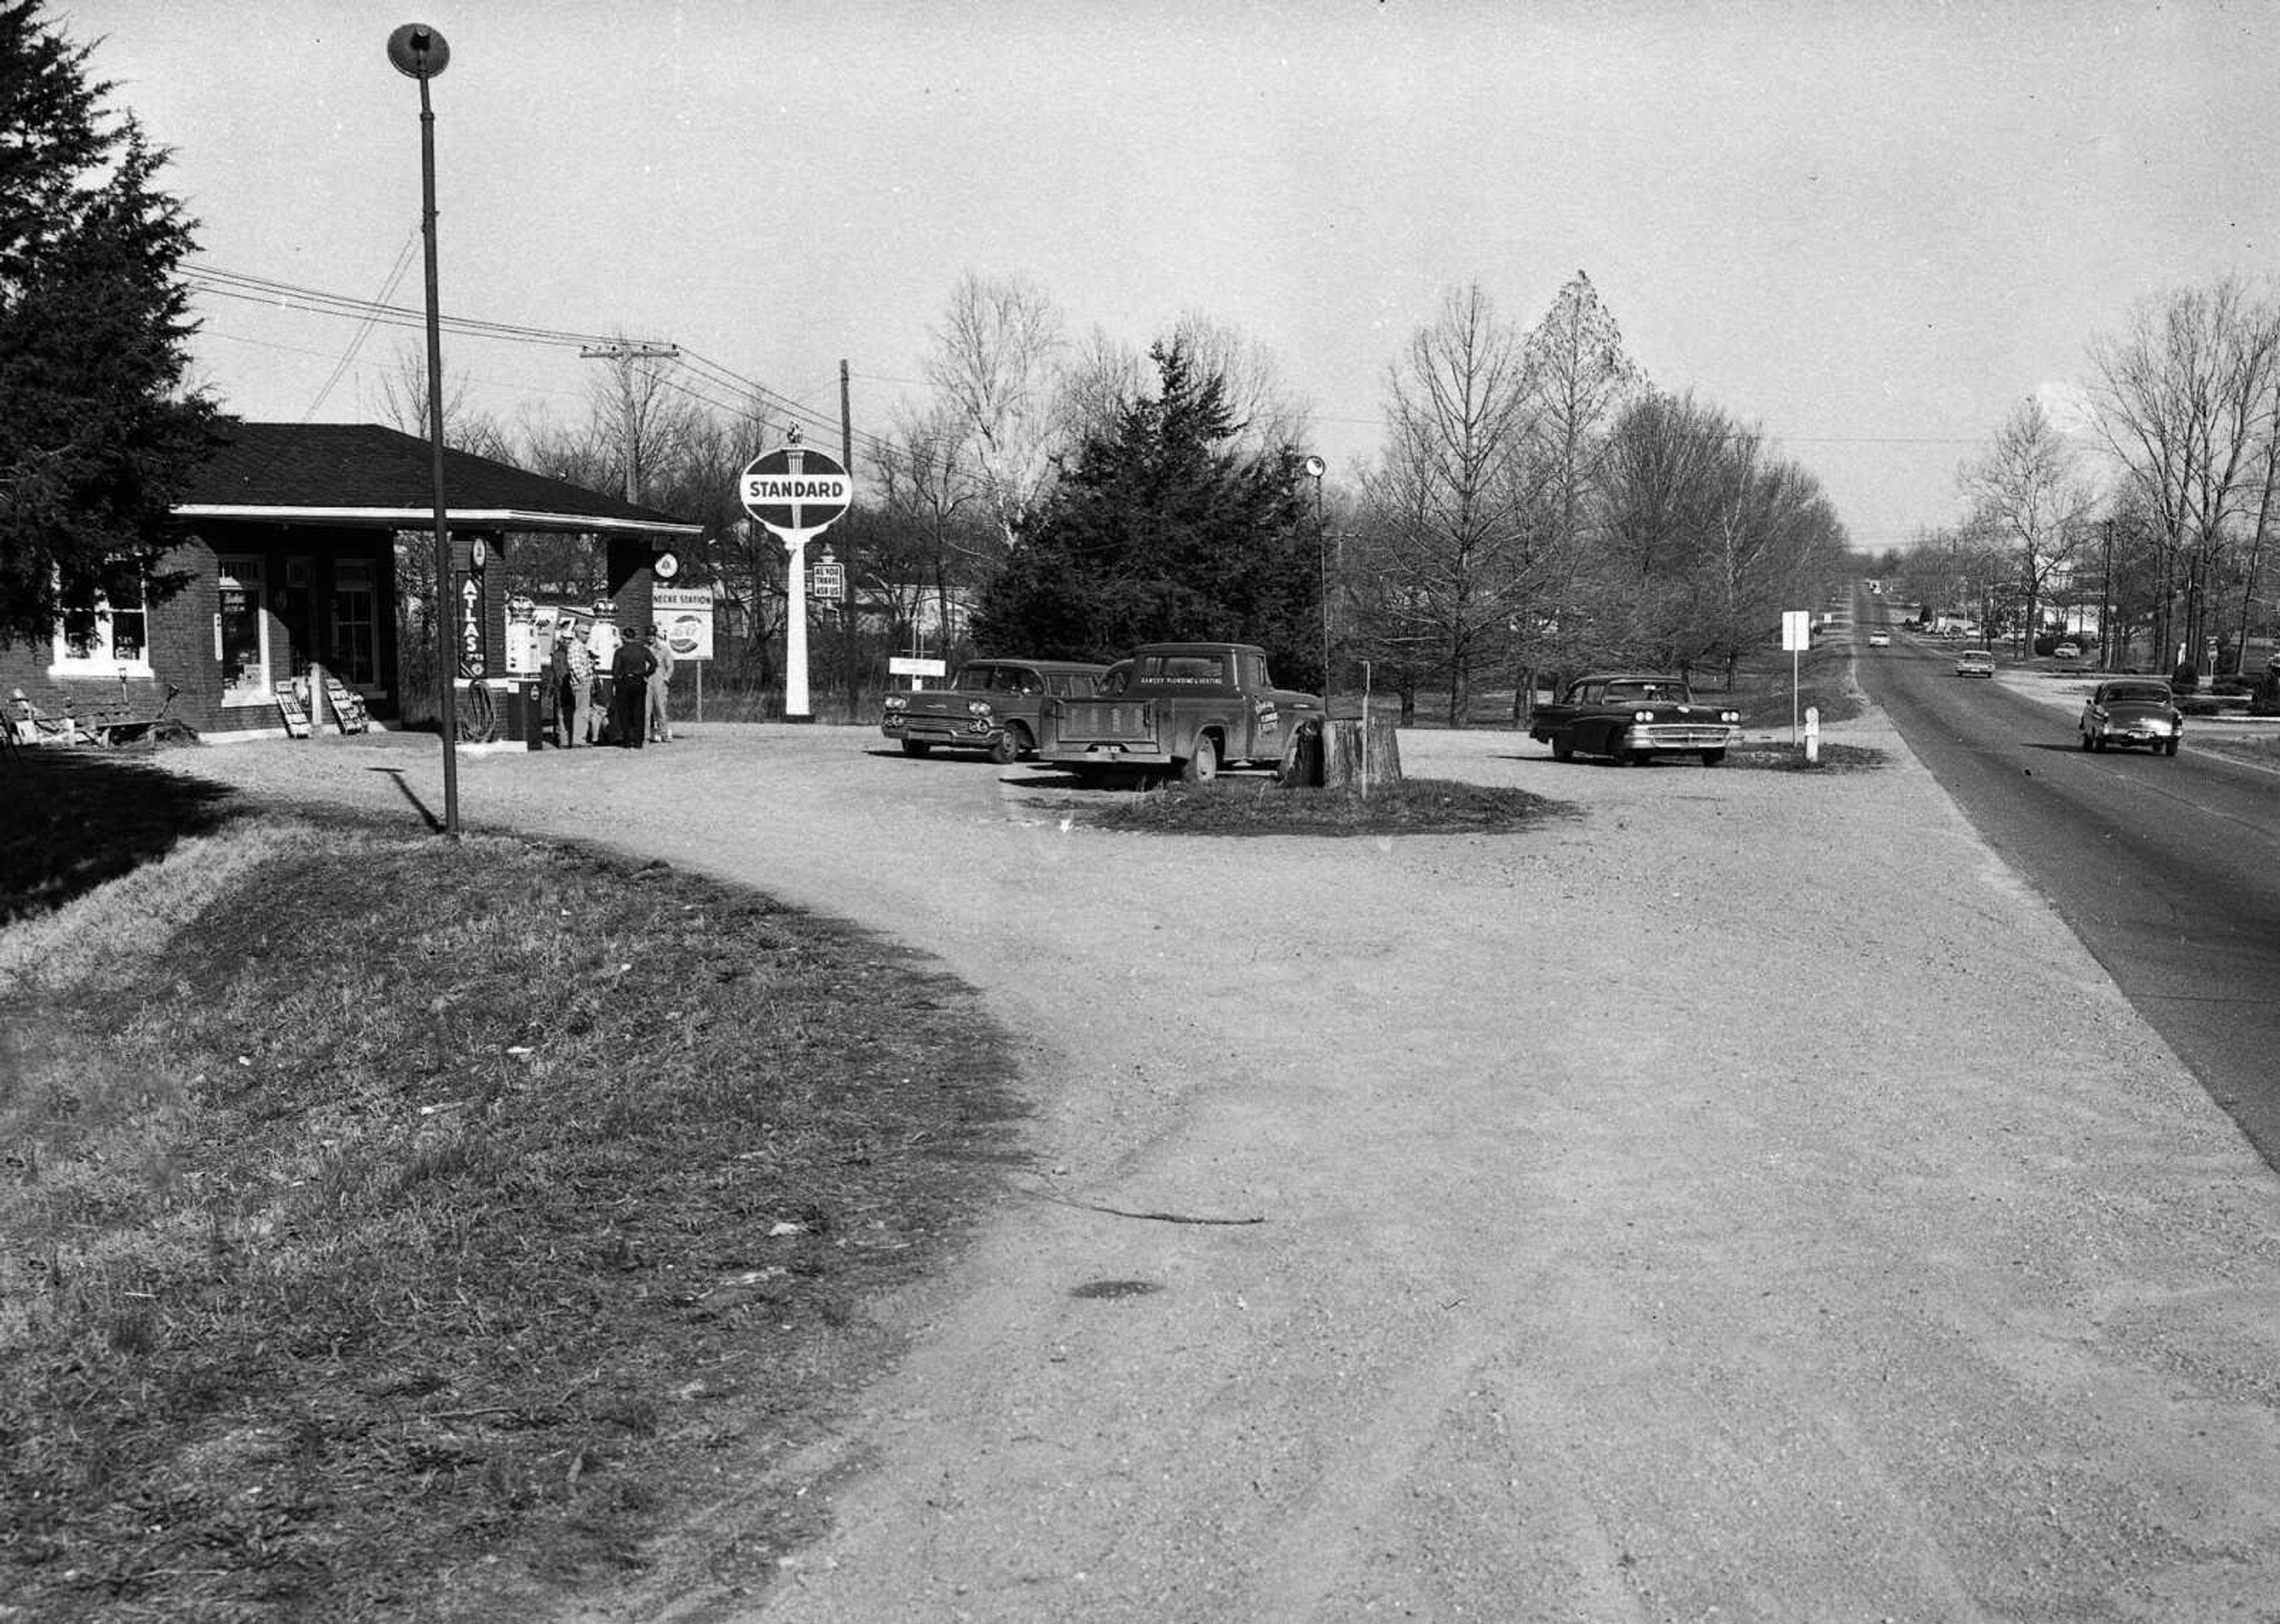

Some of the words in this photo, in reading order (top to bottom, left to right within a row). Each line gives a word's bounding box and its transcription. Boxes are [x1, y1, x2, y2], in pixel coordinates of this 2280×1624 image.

[750, 481, 843, 497] STANDARD
[680, 595, 711, 604] STATION
[463, 579, 480, 652] ATLAS
